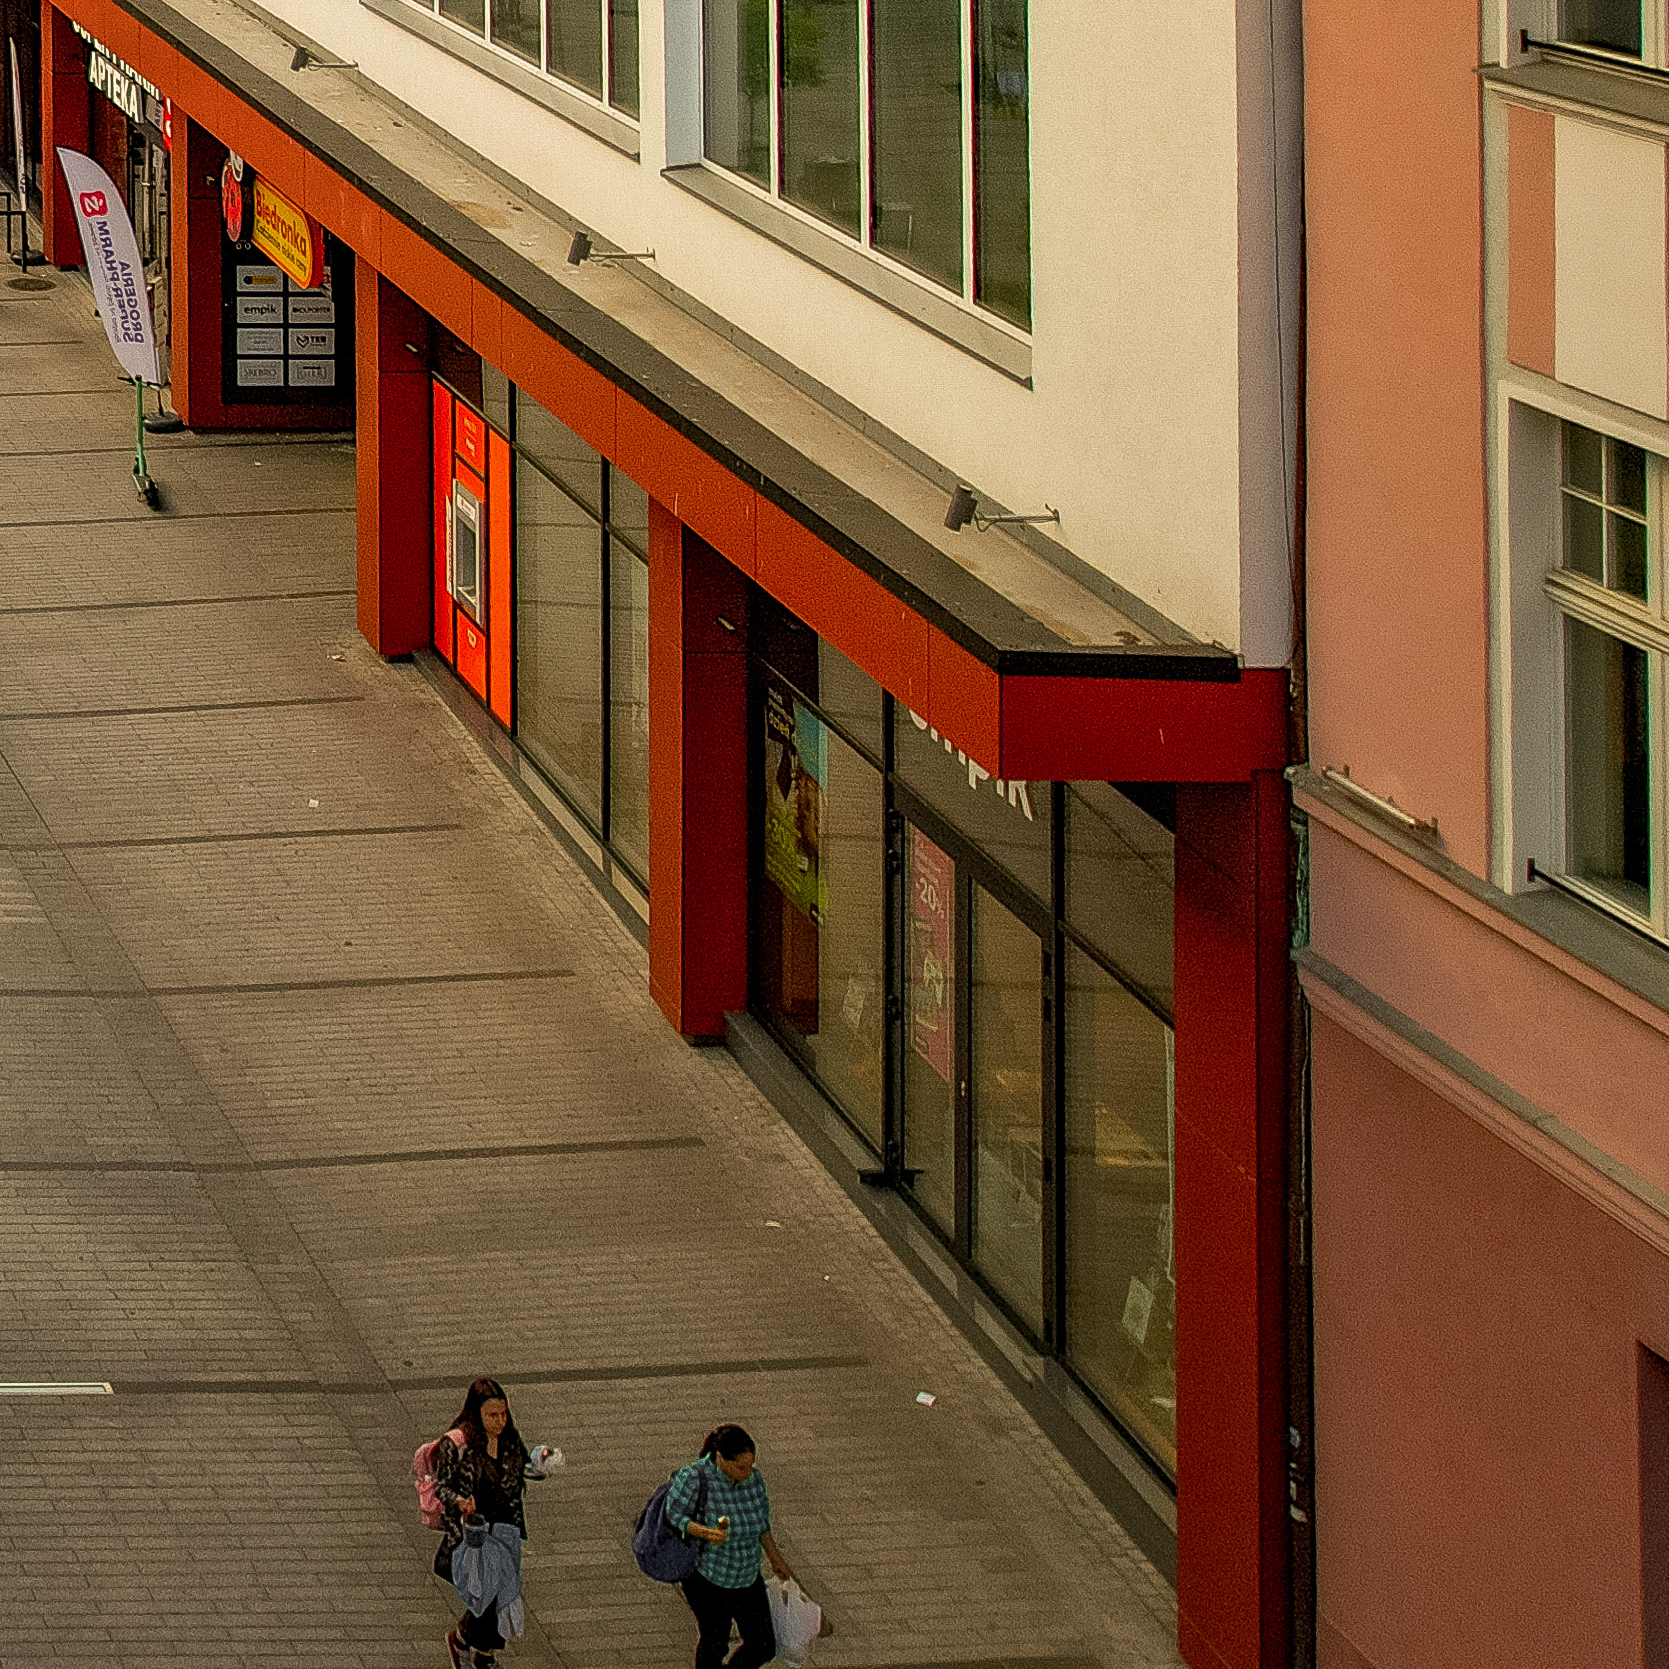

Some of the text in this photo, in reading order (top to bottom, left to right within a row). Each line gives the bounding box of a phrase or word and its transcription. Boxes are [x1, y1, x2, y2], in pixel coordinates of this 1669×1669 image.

[89, 50, 140, 124] APTEKA
[255, 188, 307, 260] Biedronka
[243, 303, 278, 315] empik
